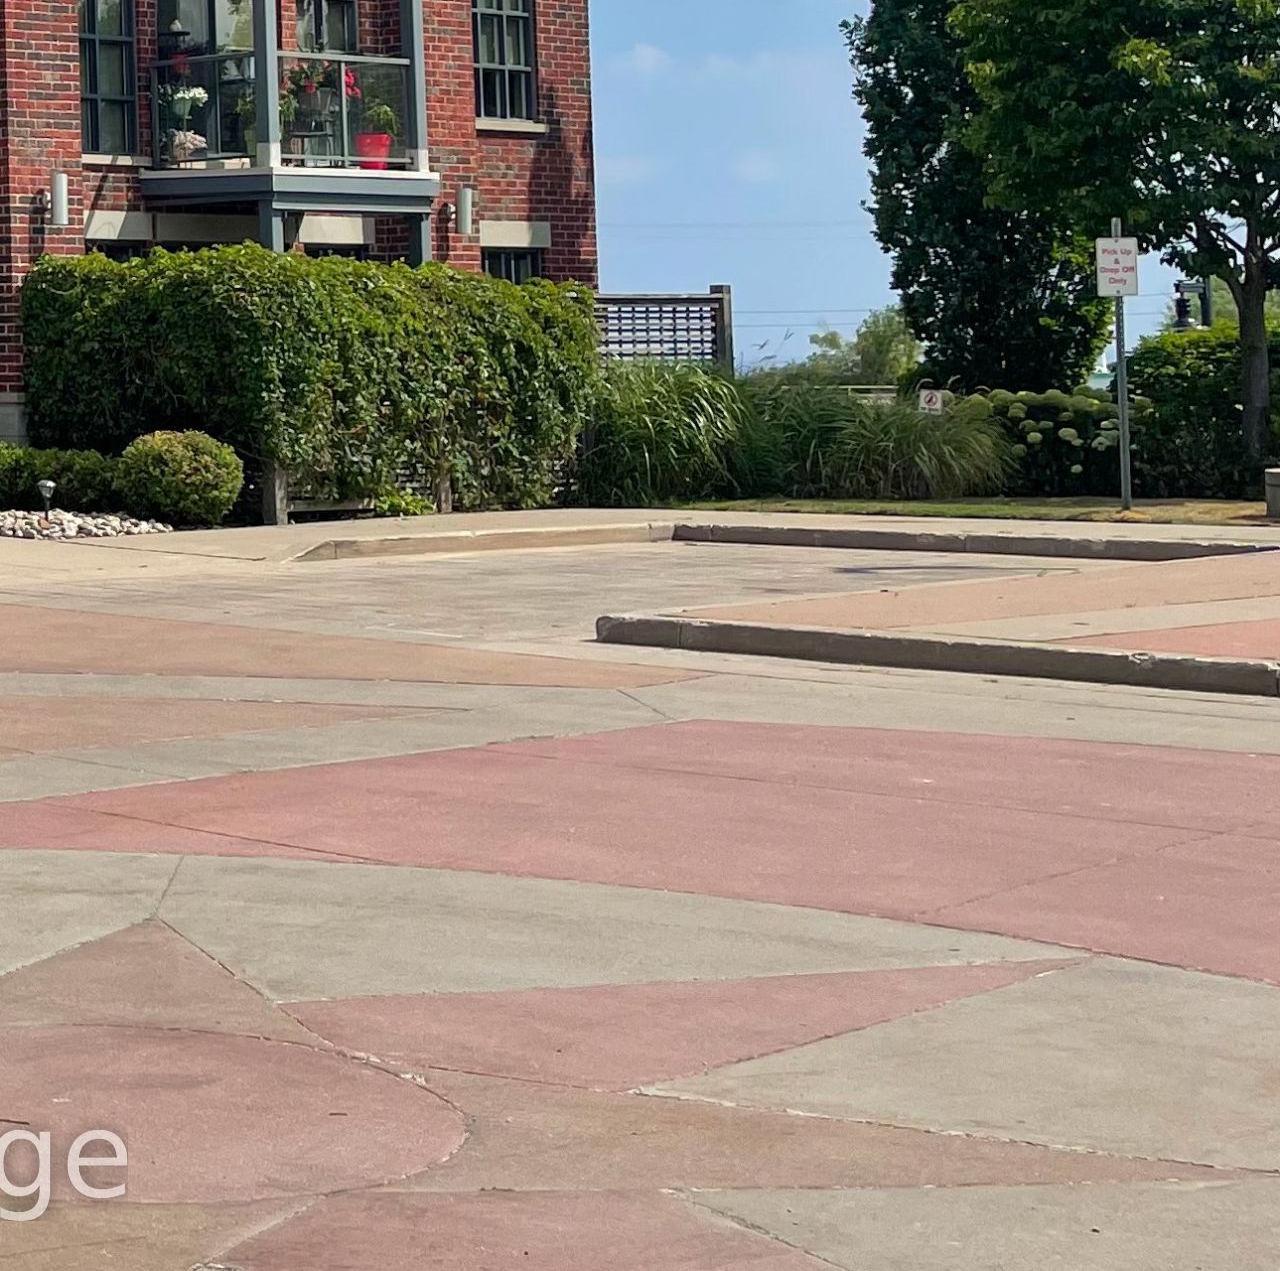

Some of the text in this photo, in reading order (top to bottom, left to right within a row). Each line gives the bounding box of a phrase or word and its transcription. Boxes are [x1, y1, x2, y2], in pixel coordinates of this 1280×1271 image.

[1120, 248, 1132, 256] Up
[1099, 265, 1135, 274] Drop Off
[1108, 277, 1127, 285] Only
